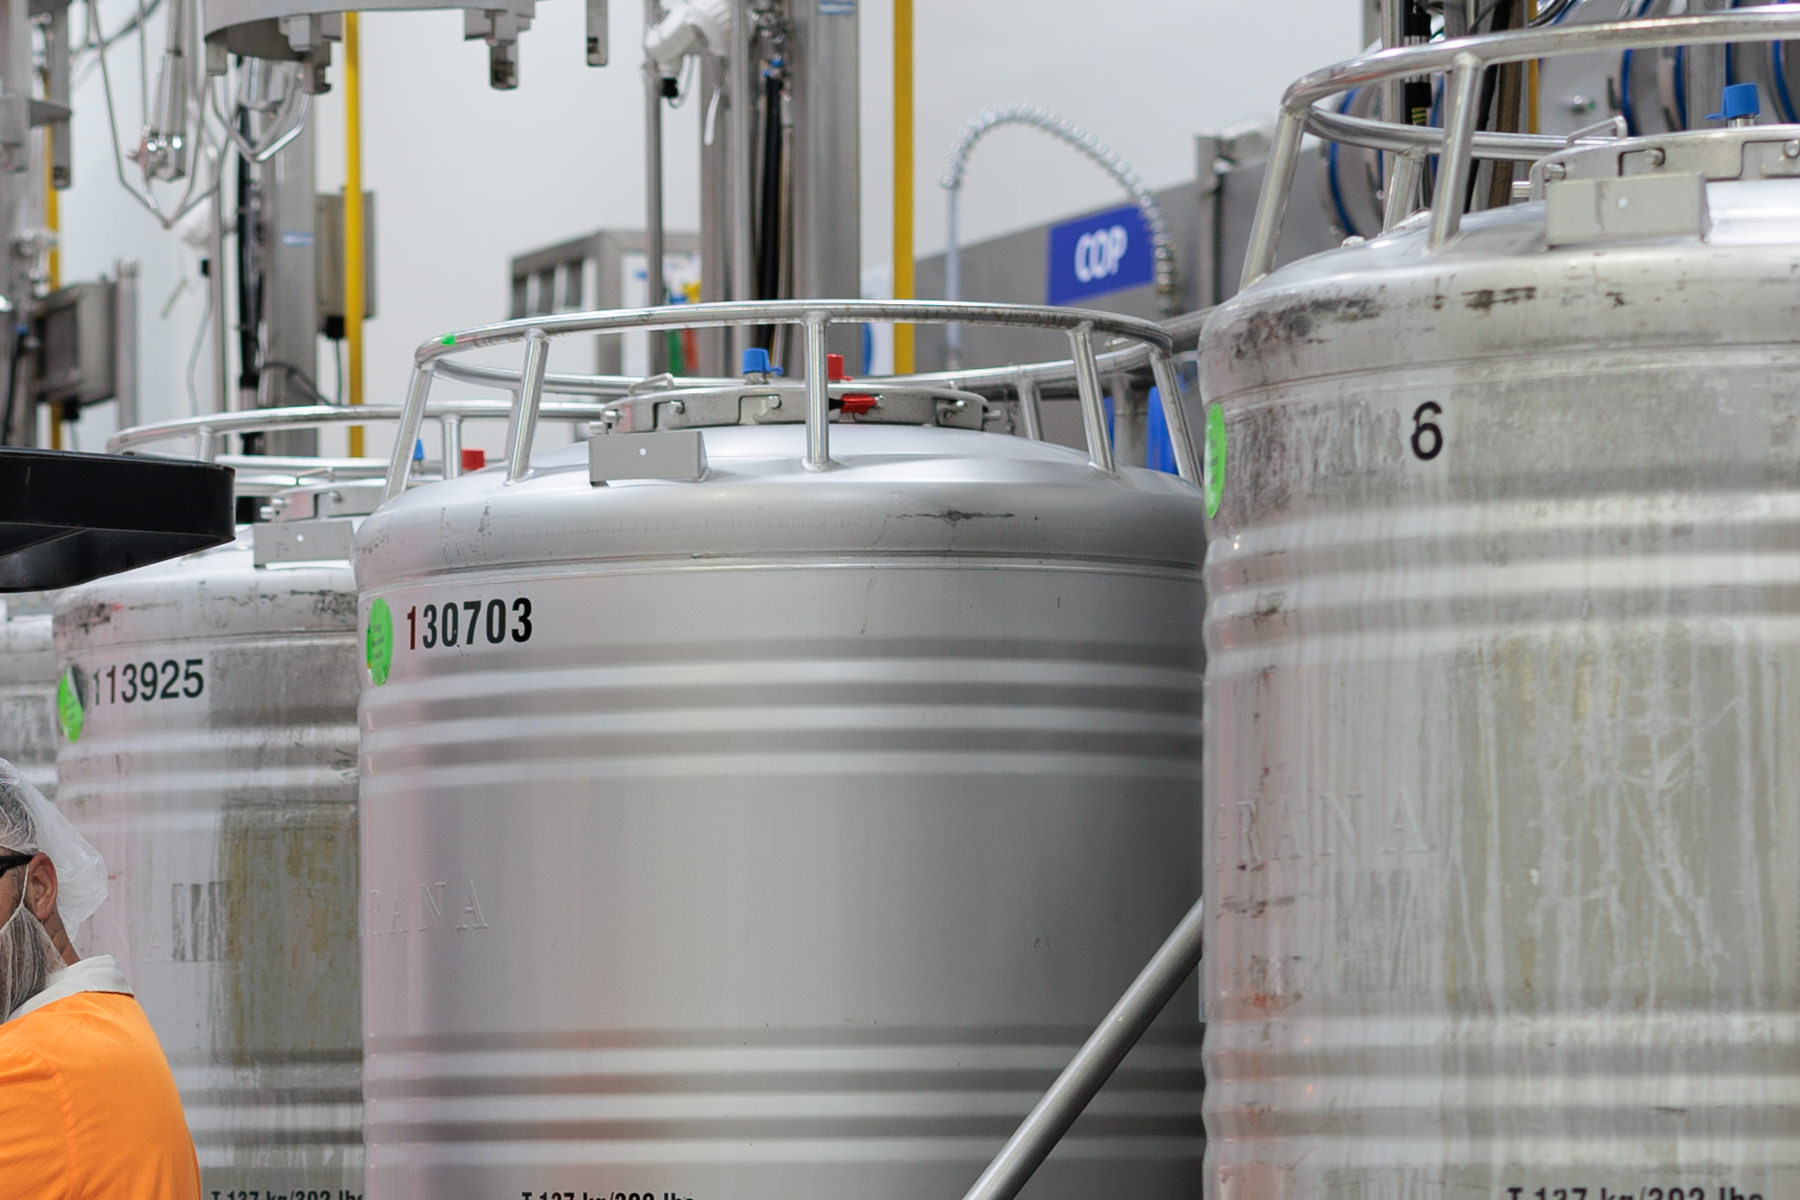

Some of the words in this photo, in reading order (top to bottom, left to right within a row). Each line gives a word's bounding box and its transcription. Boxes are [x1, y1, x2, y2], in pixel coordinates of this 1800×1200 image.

[1075, 225, 1128, 283] COP
[1411, 401, 1443, 460] 6
[407, 598, 532, 650] 130703
[93, 659, 204, 706] 113925
